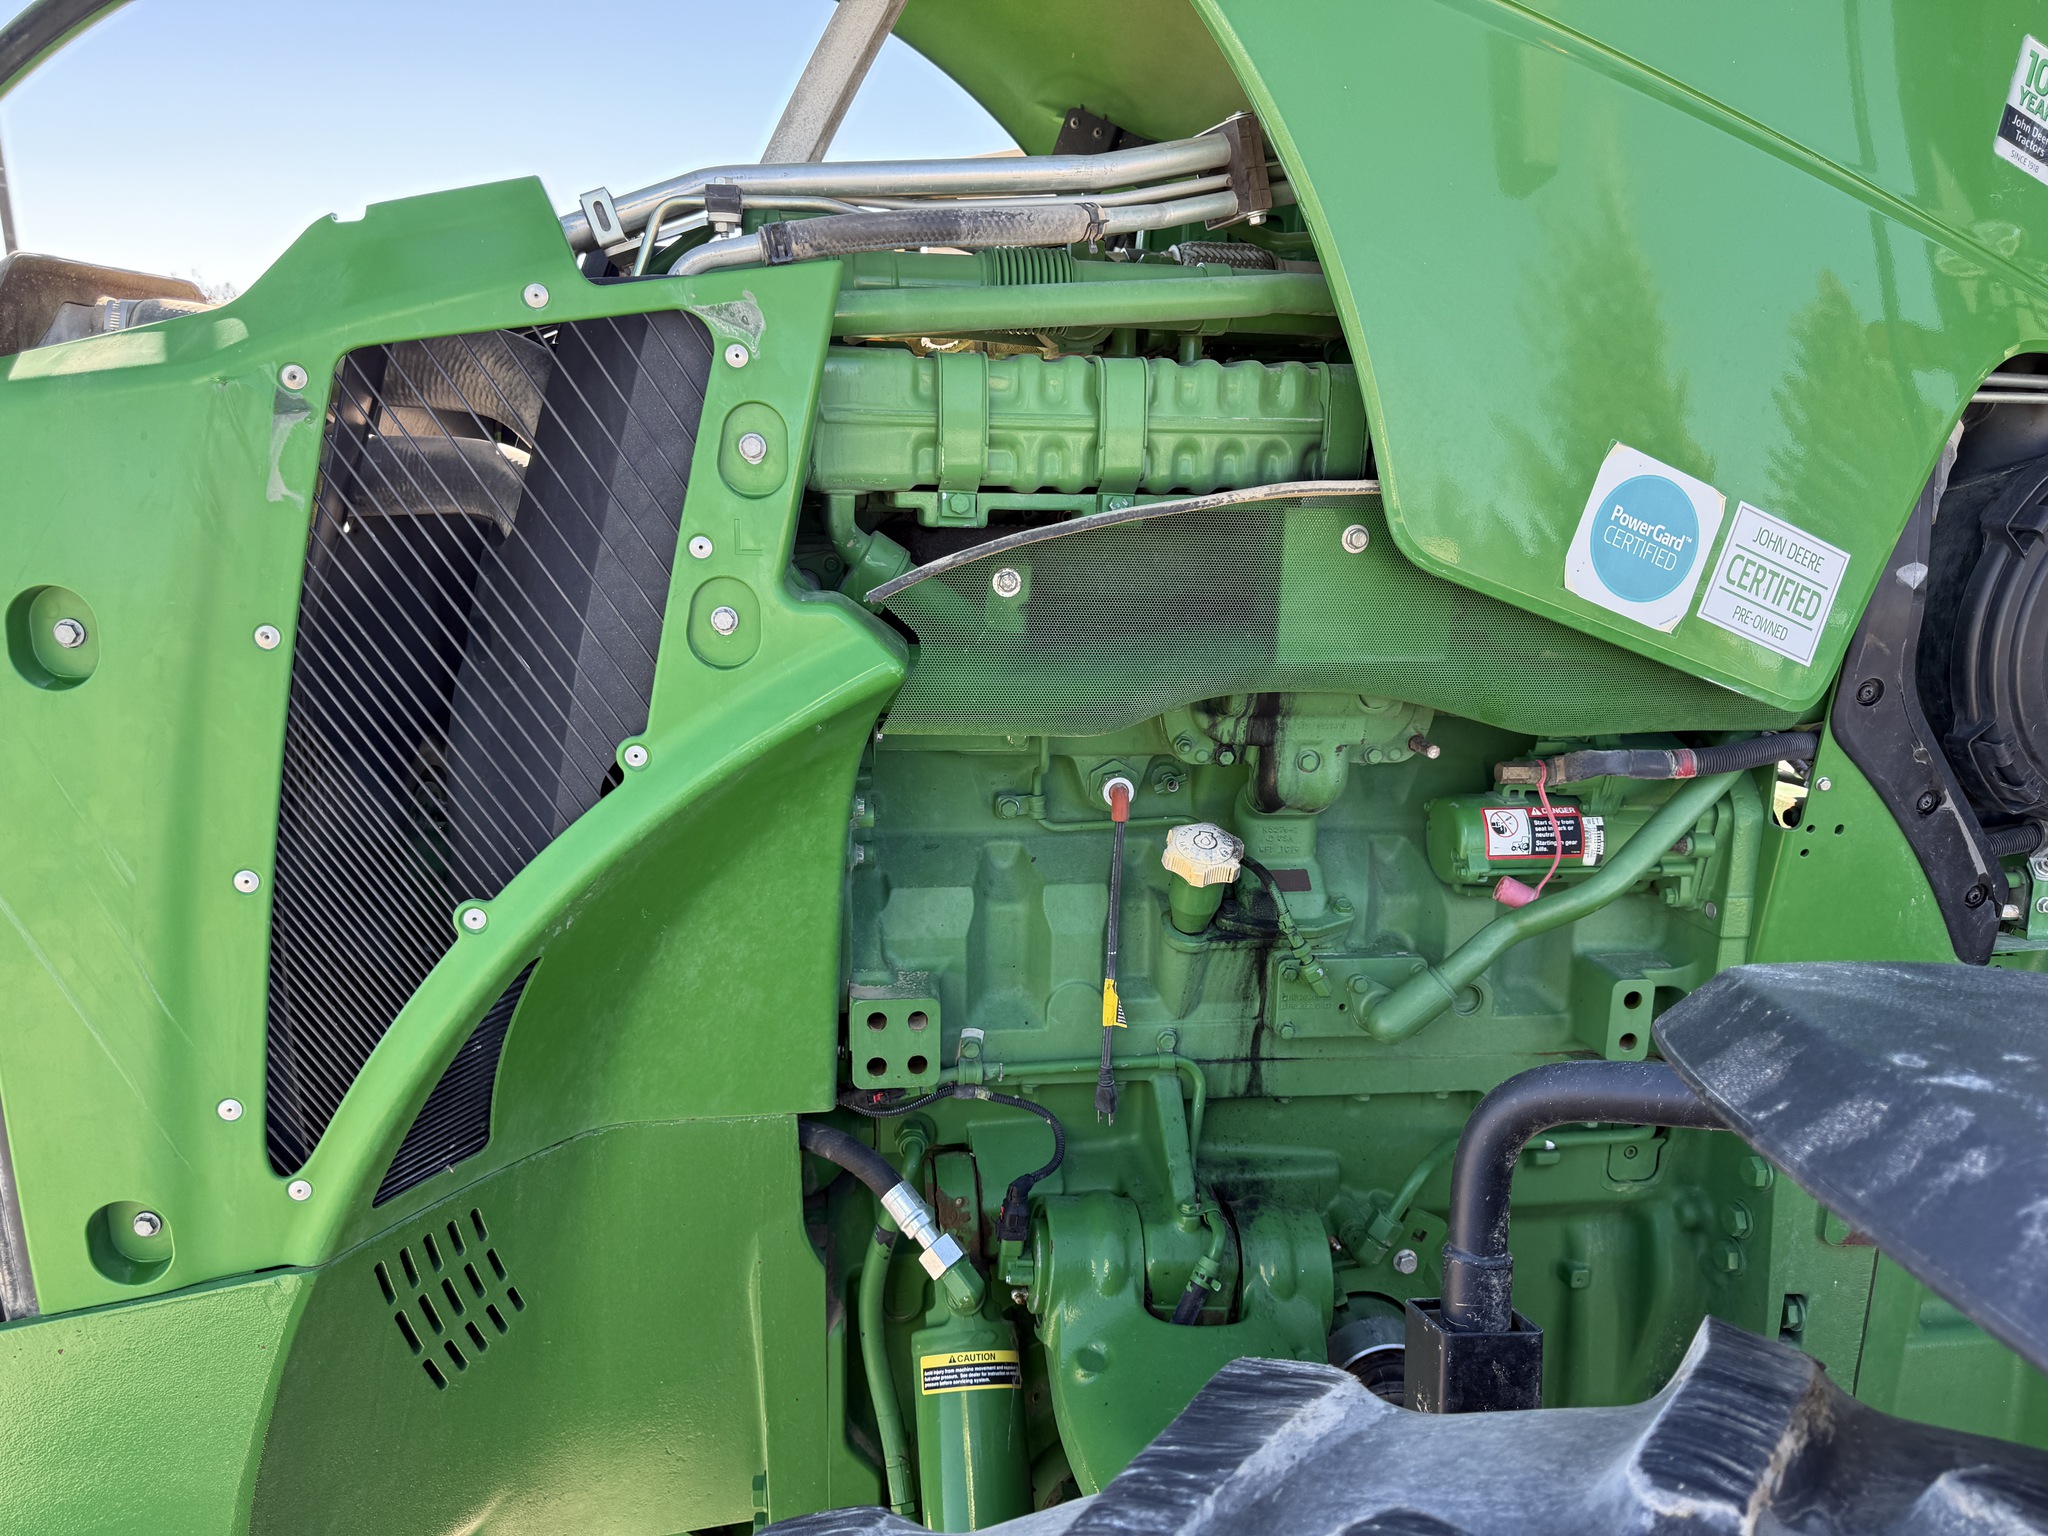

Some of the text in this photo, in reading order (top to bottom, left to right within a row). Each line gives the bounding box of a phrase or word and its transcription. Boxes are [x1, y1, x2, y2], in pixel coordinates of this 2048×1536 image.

[2011, 114, 2031, 134] John
[2015, 129, 2045, 157] Tractors
[2011, 149, 2040, 173] SINCE 1918
[1603, 525, 1678, 571] CERTIFIED
[1752, 526, 1825, 574] JOHN DEERE
[1725, 553, 1822, 622] CERTIFIED
[1732, 605, 1789, 642] PRE-OWNED
[957, 1353, 996, 1363] CAUTION
